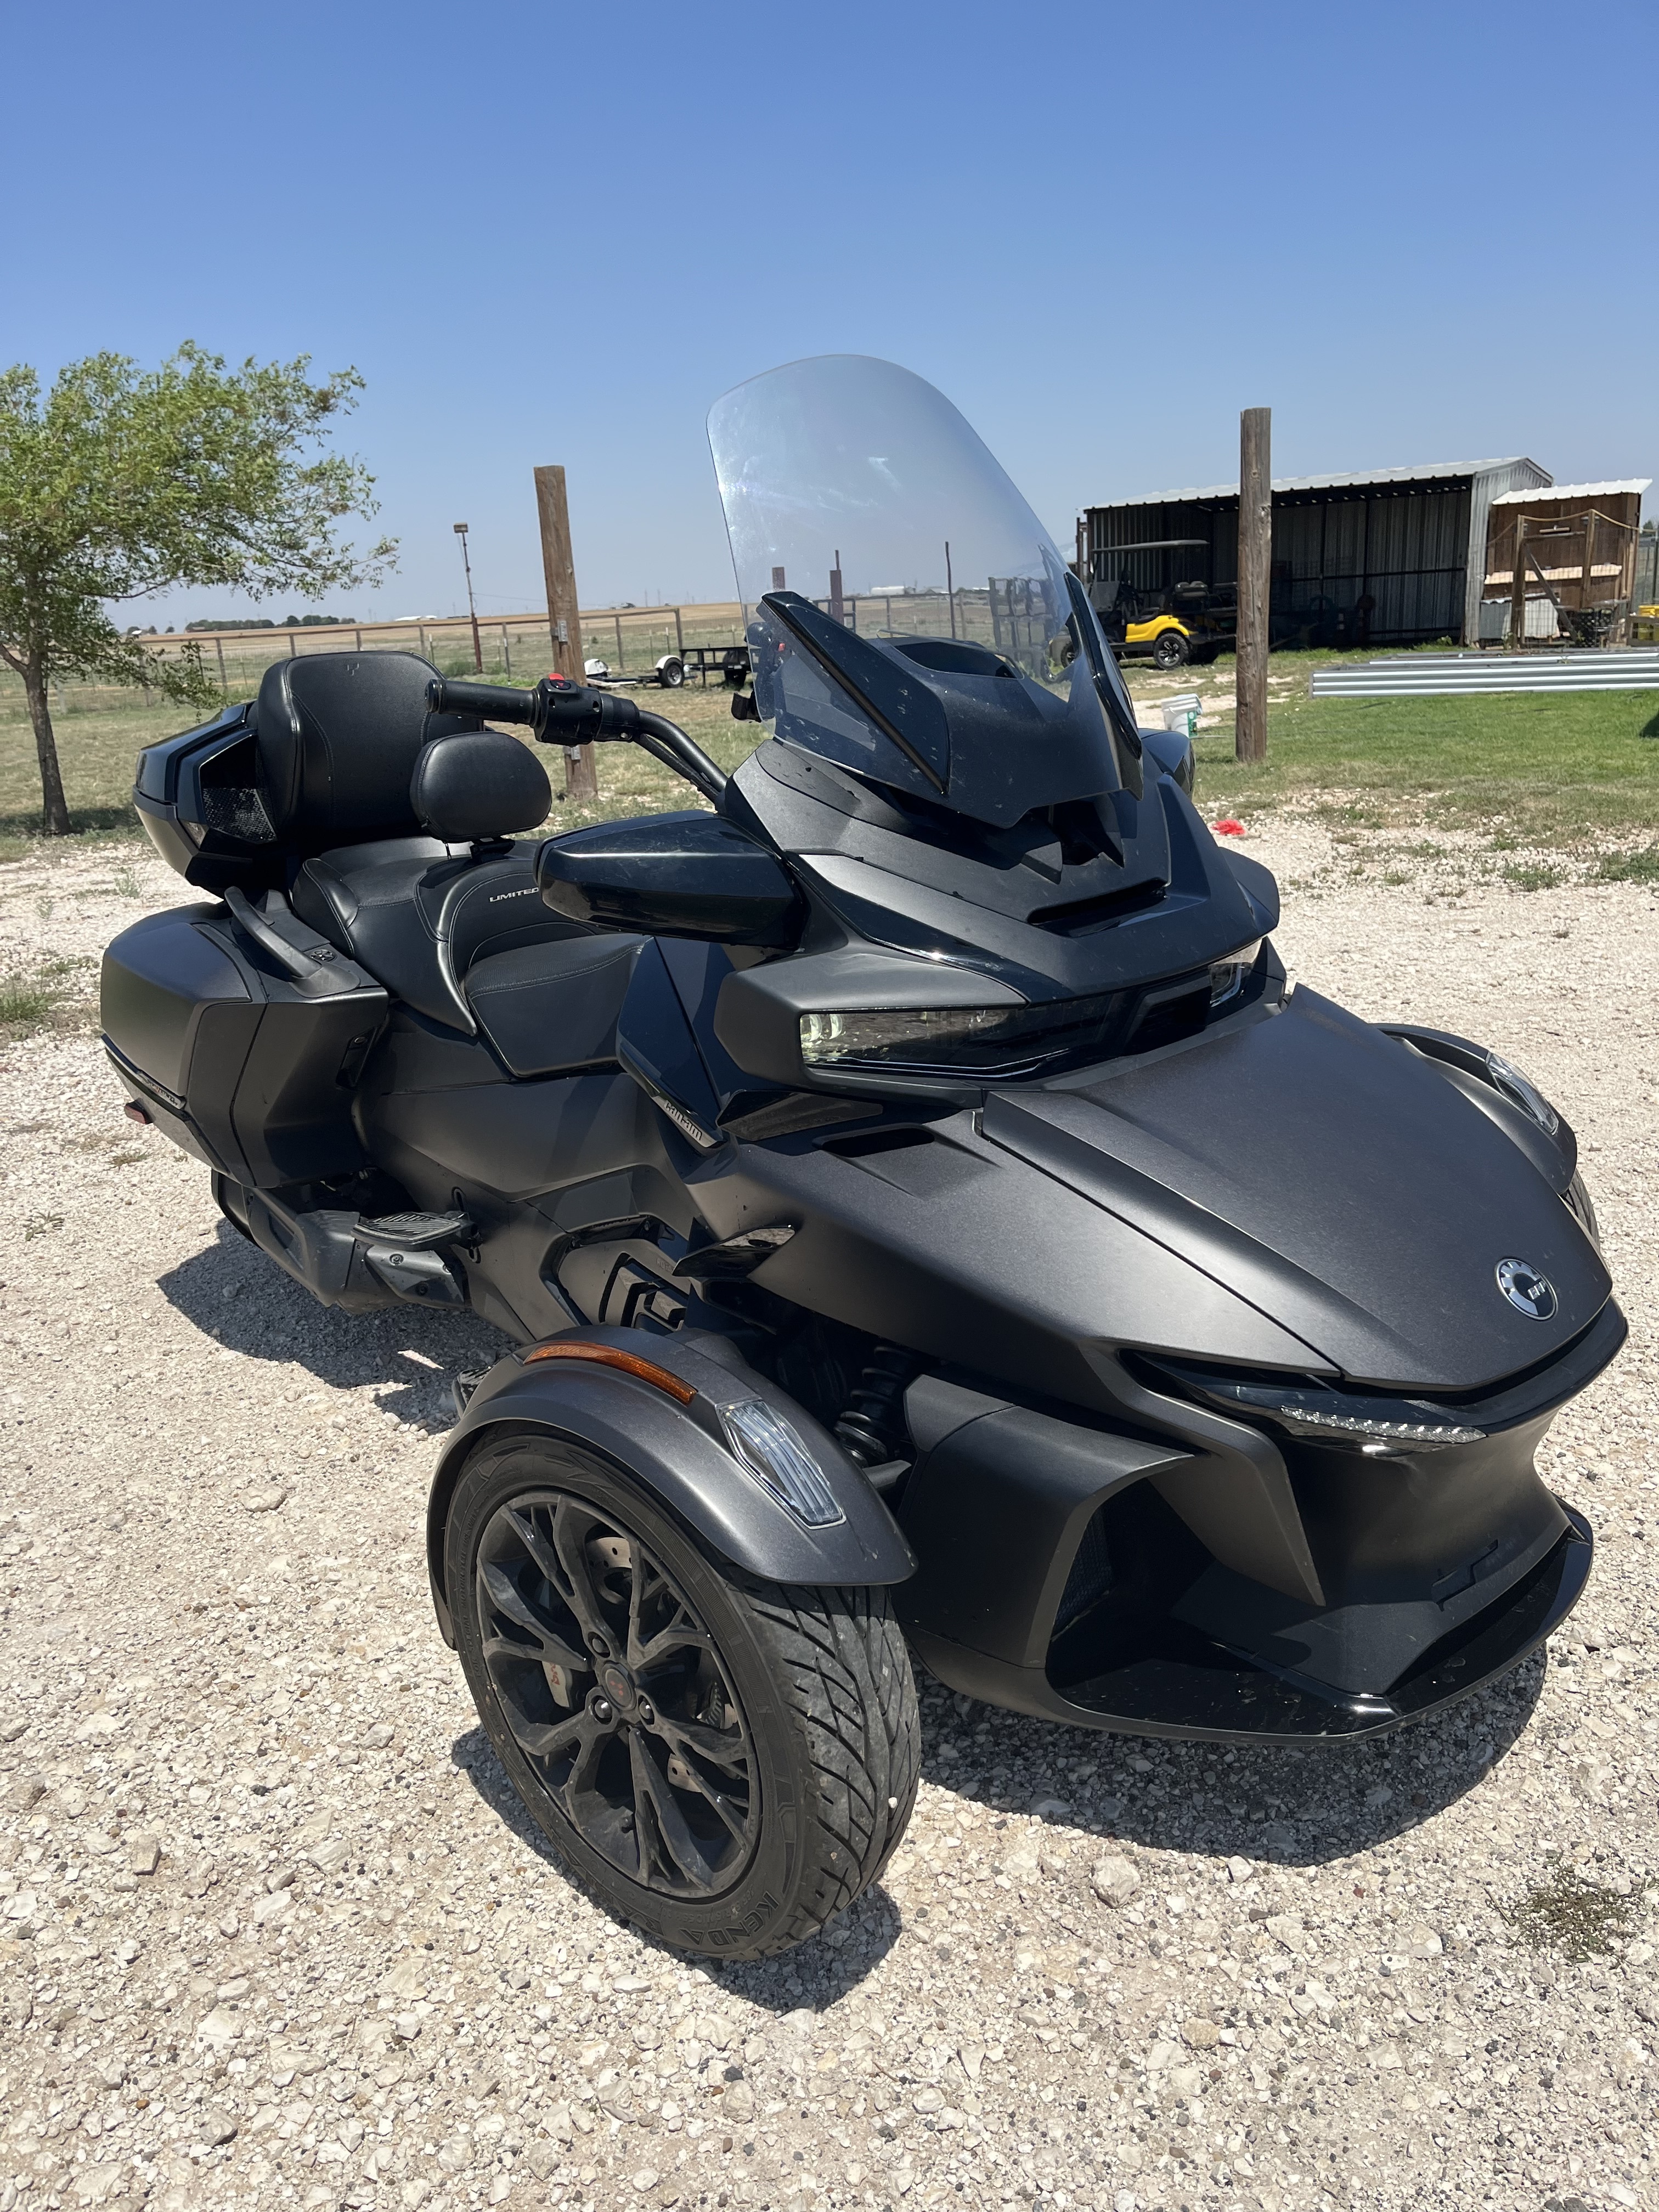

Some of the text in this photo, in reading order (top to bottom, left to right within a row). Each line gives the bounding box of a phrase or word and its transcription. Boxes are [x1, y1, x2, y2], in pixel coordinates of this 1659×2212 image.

[489, 887, 539, 902] LIMITED
[664, 1100, 703, 1141] can-am
[1527, 1281, 1546, 1300] BRP
[679, 1891, 780, 1946] KENDA
